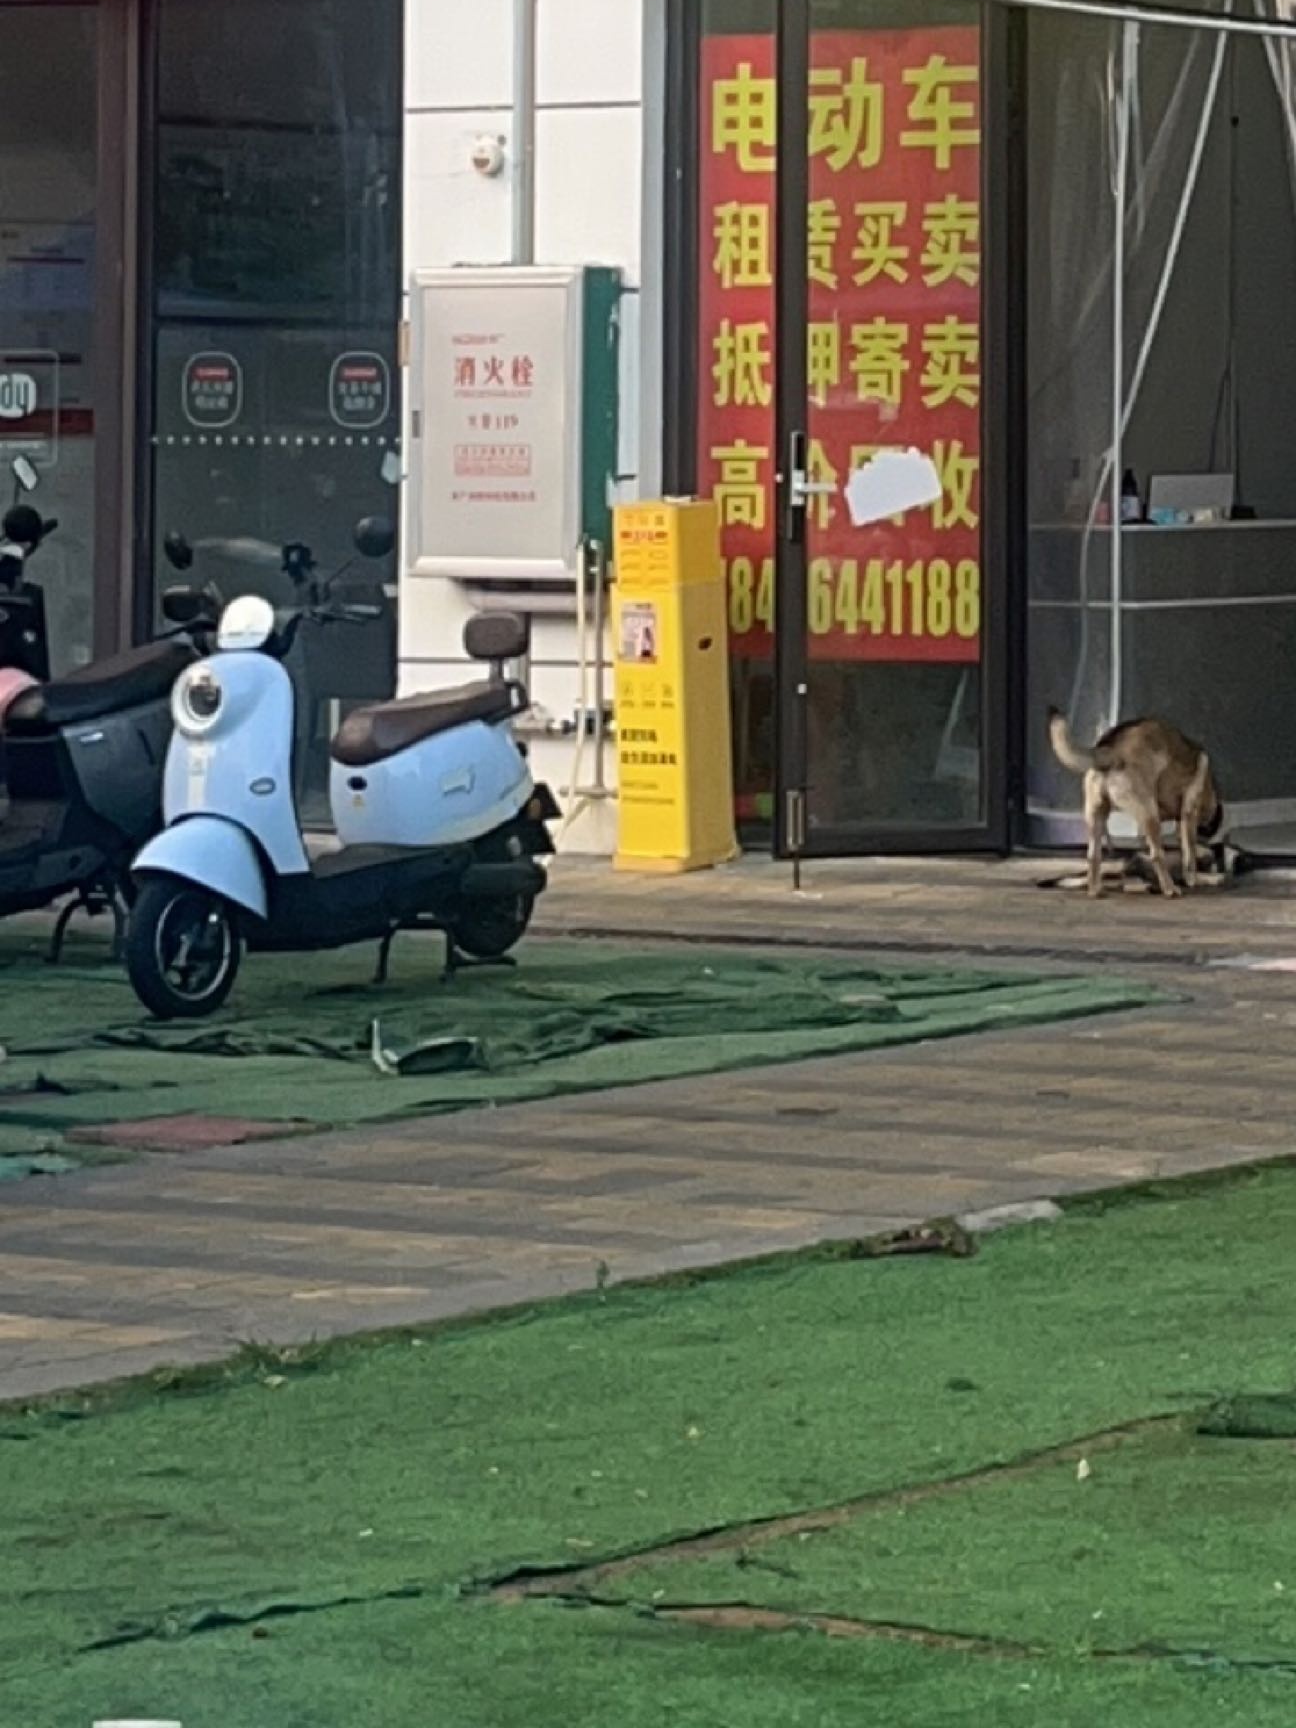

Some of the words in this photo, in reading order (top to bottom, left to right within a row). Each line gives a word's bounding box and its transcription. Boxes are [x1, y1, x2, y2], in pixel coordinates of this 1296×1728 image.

[712, 54, 981, 172] 电动车
[454, 354, 534, 387] 消火栓
[710, 438, 980, 530] 高收
[719, 556, 980, 638] 846441188
